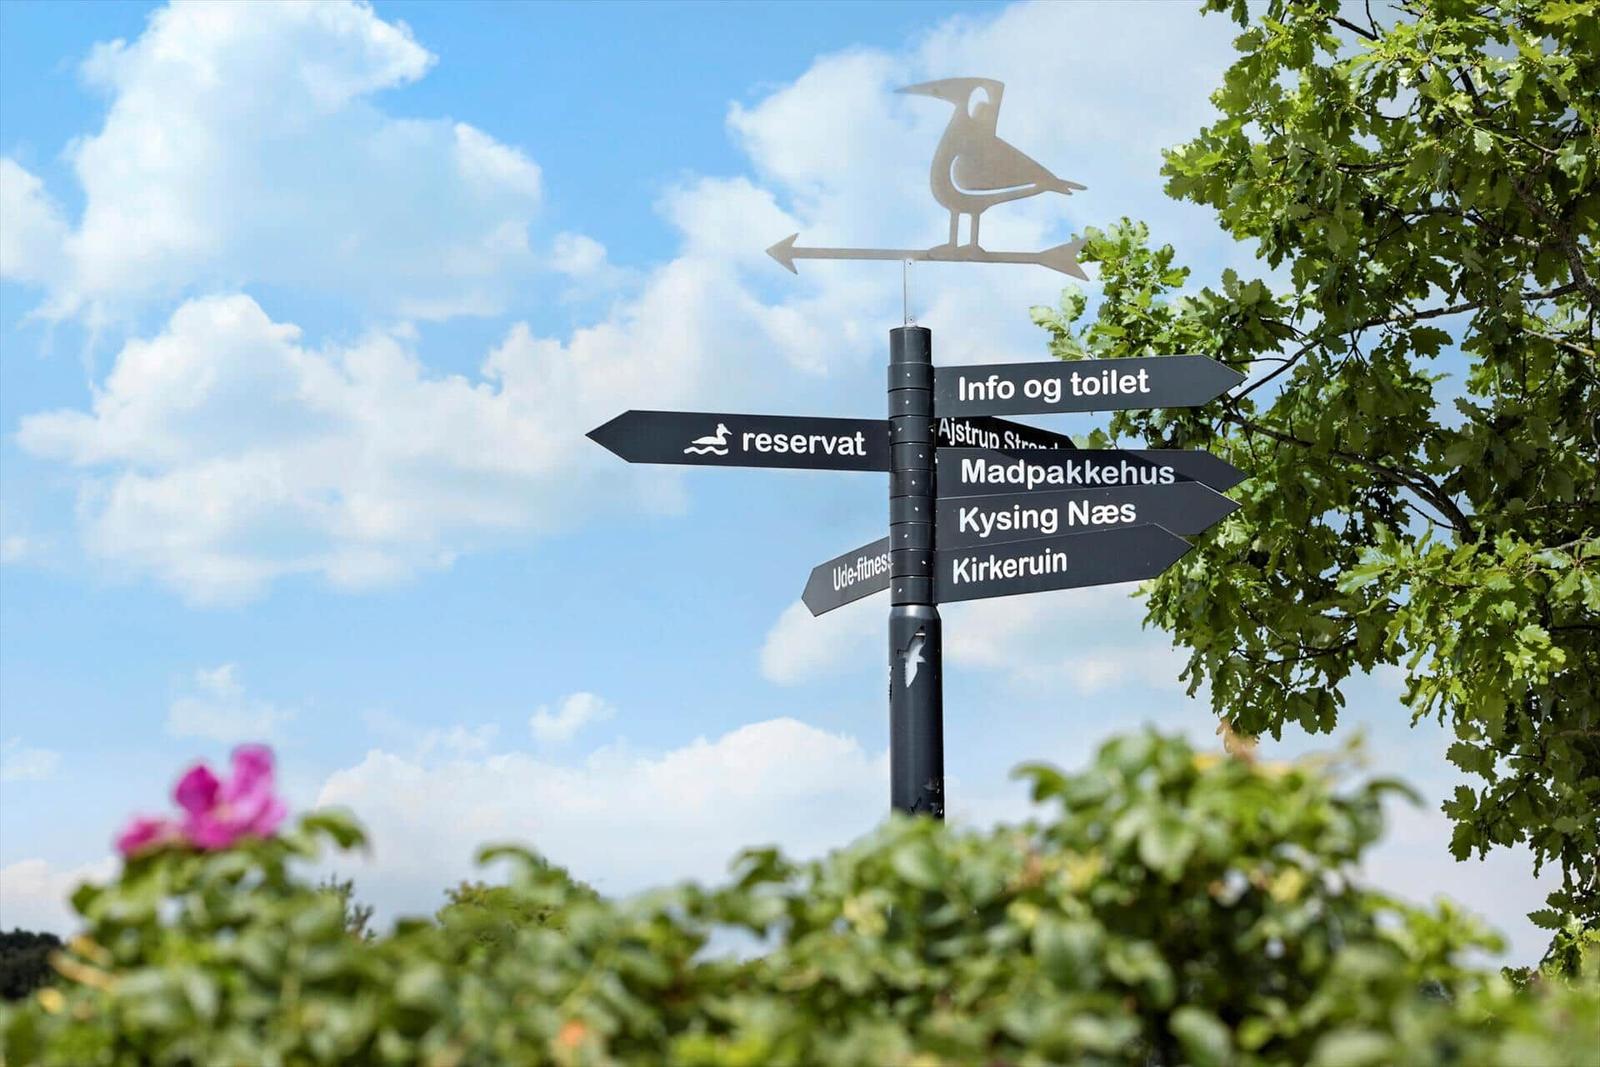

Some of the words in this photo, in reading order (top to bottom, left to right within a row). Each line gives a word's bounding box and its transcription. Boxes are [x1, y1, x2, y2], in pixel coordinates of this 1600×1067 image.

[958, 375, 1015, 402] Info
[1023, 379, 1062, 404] og
[1070, 368, 1151, 397] toilet
[742, 432, 867, 456] reservat
[938, 416, 1000, 448] Ajstrup
[961, 458, 1175, 489] Madpakkehus
[959, 505, 1058, 538] Kysing
[1069, 500, 1136, 527] Næs
[952, 548, 1067, 584] Kirkeruin
